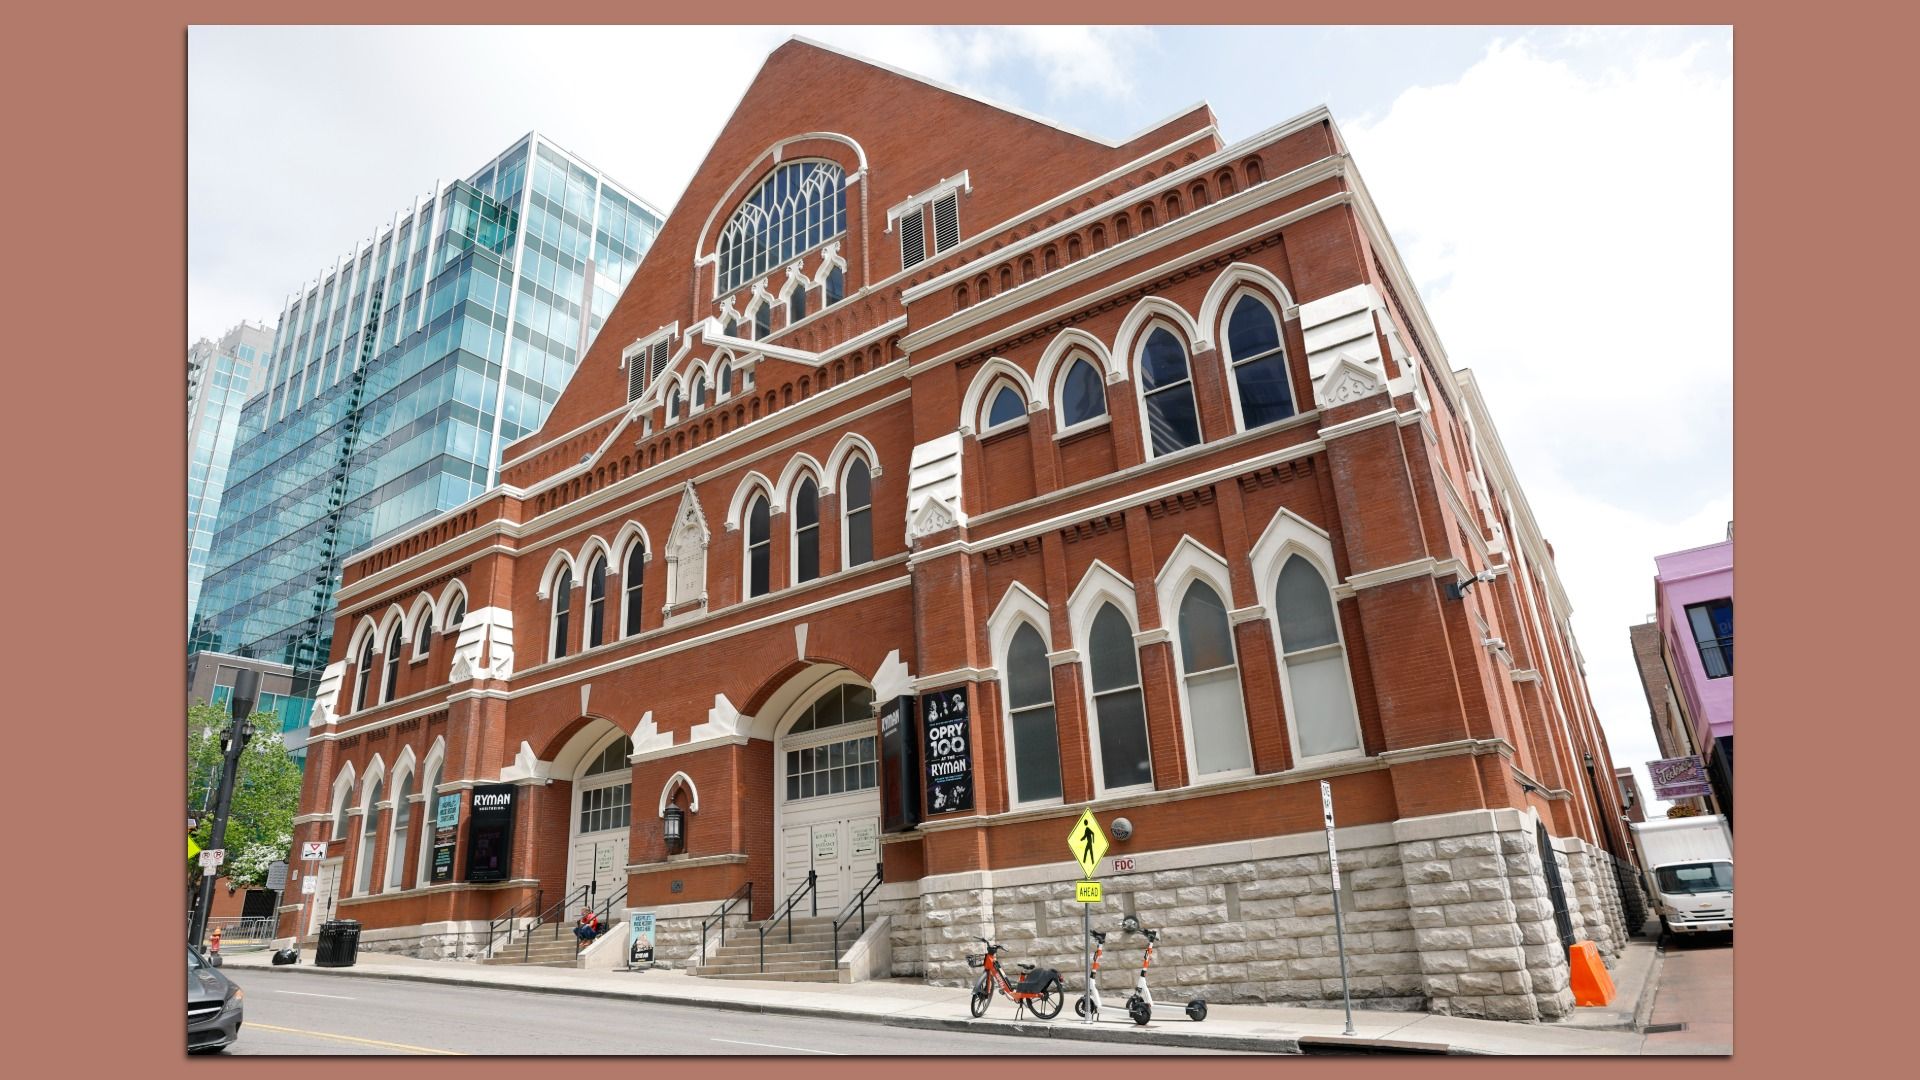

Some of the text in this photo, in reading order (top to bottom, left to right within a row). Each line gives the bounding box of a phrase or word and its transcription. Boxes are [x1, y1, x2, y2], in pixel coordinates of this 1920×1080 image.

[929, 722, 964, 740] OPRY
[930, 736, 966, 757] 100
[931, 758, 967, 777] RYMAN
[474, 794, 511, 806] RYMAN
[1114, 859, 1134, 871] FDC
[1079, 887, 1099, 897] AHEAD
